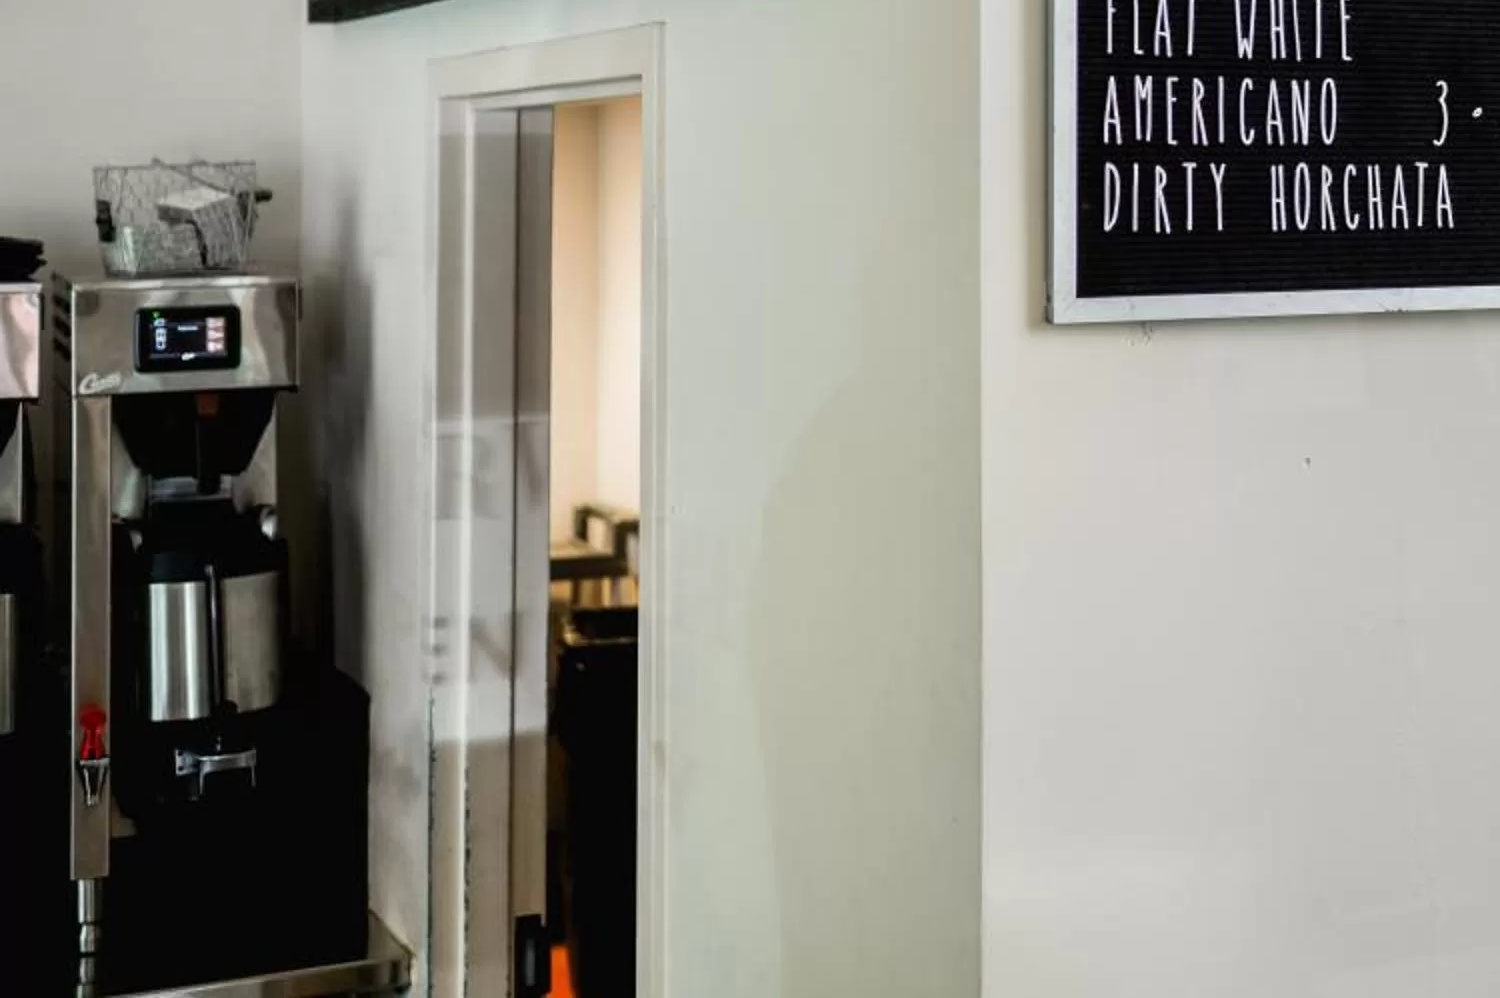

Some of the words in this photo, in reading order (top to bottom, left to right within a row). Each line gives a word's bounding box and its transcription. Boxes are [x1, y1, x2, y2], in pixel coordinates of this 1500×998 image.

[1103, 74, 1337, 146] AMERICANO
[1432, 80, 1449, 147] 3
[1103, 161, 1227, 235] DIRTY
[1270, 161, 1455, 232] HORCHATA
